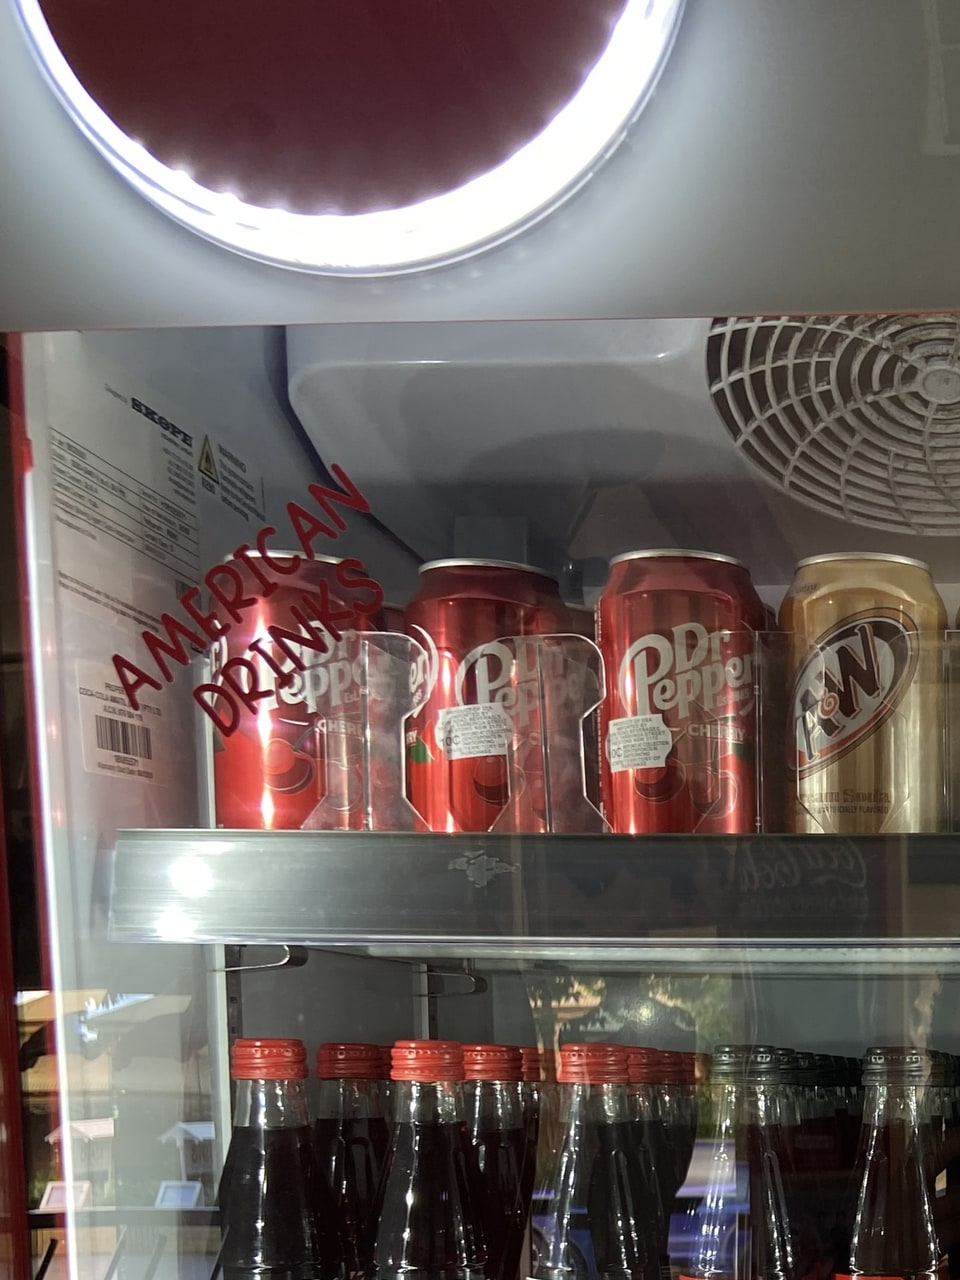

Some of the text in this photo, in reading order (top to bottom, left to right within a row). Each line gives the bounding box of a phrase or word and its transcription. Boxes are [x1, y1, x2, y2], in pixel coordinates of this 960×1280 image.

[112, 464, 371, 711] AMERICAN
[194, 558, 383, 737] DRINKS
[673, 622, 731, 675] Dr
[686, 721, 747, 743] CHERRY
